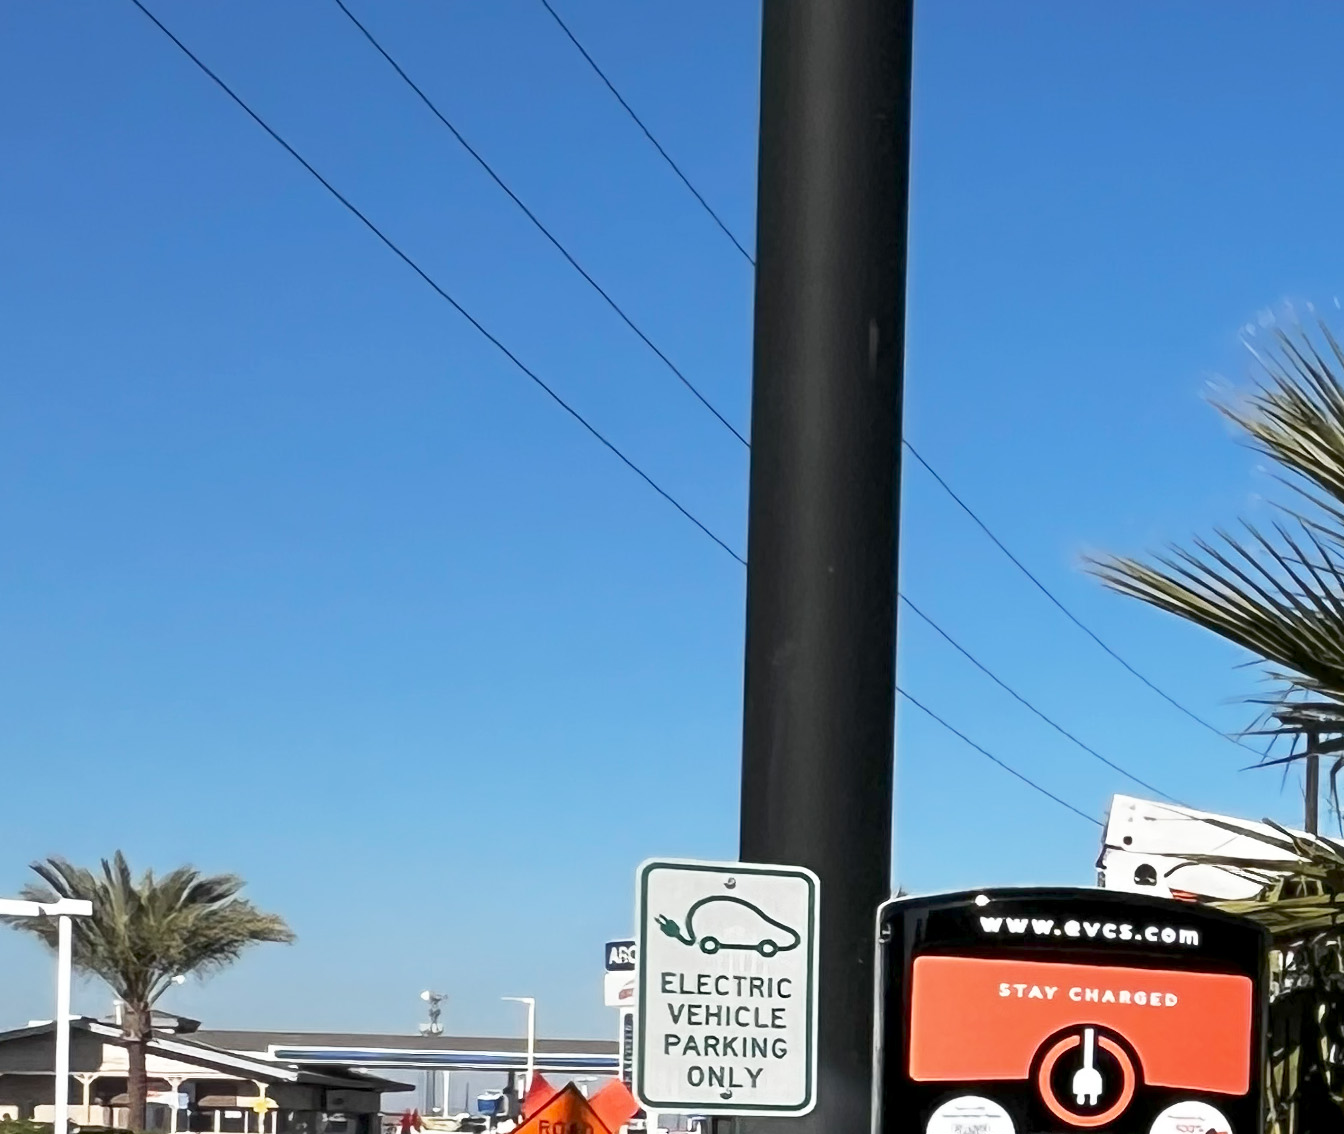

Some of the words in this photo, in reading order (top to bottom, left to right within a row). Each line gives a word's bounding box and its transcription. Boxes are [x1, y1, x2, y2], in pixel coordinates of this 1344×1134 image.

[979, 916, 1199, 946] www.evcs.com
[661, 971, 792, 999] ELECTRIC
[998, 982, 1059, 1000] STAY
[1068, 986, 1179, 1007] CHARGED
[667, 1003, 787, 1029] VEHICLE
[664, 1033, 788, 1060] PARKING
[686, 1065, 764, 1089] ONLY
